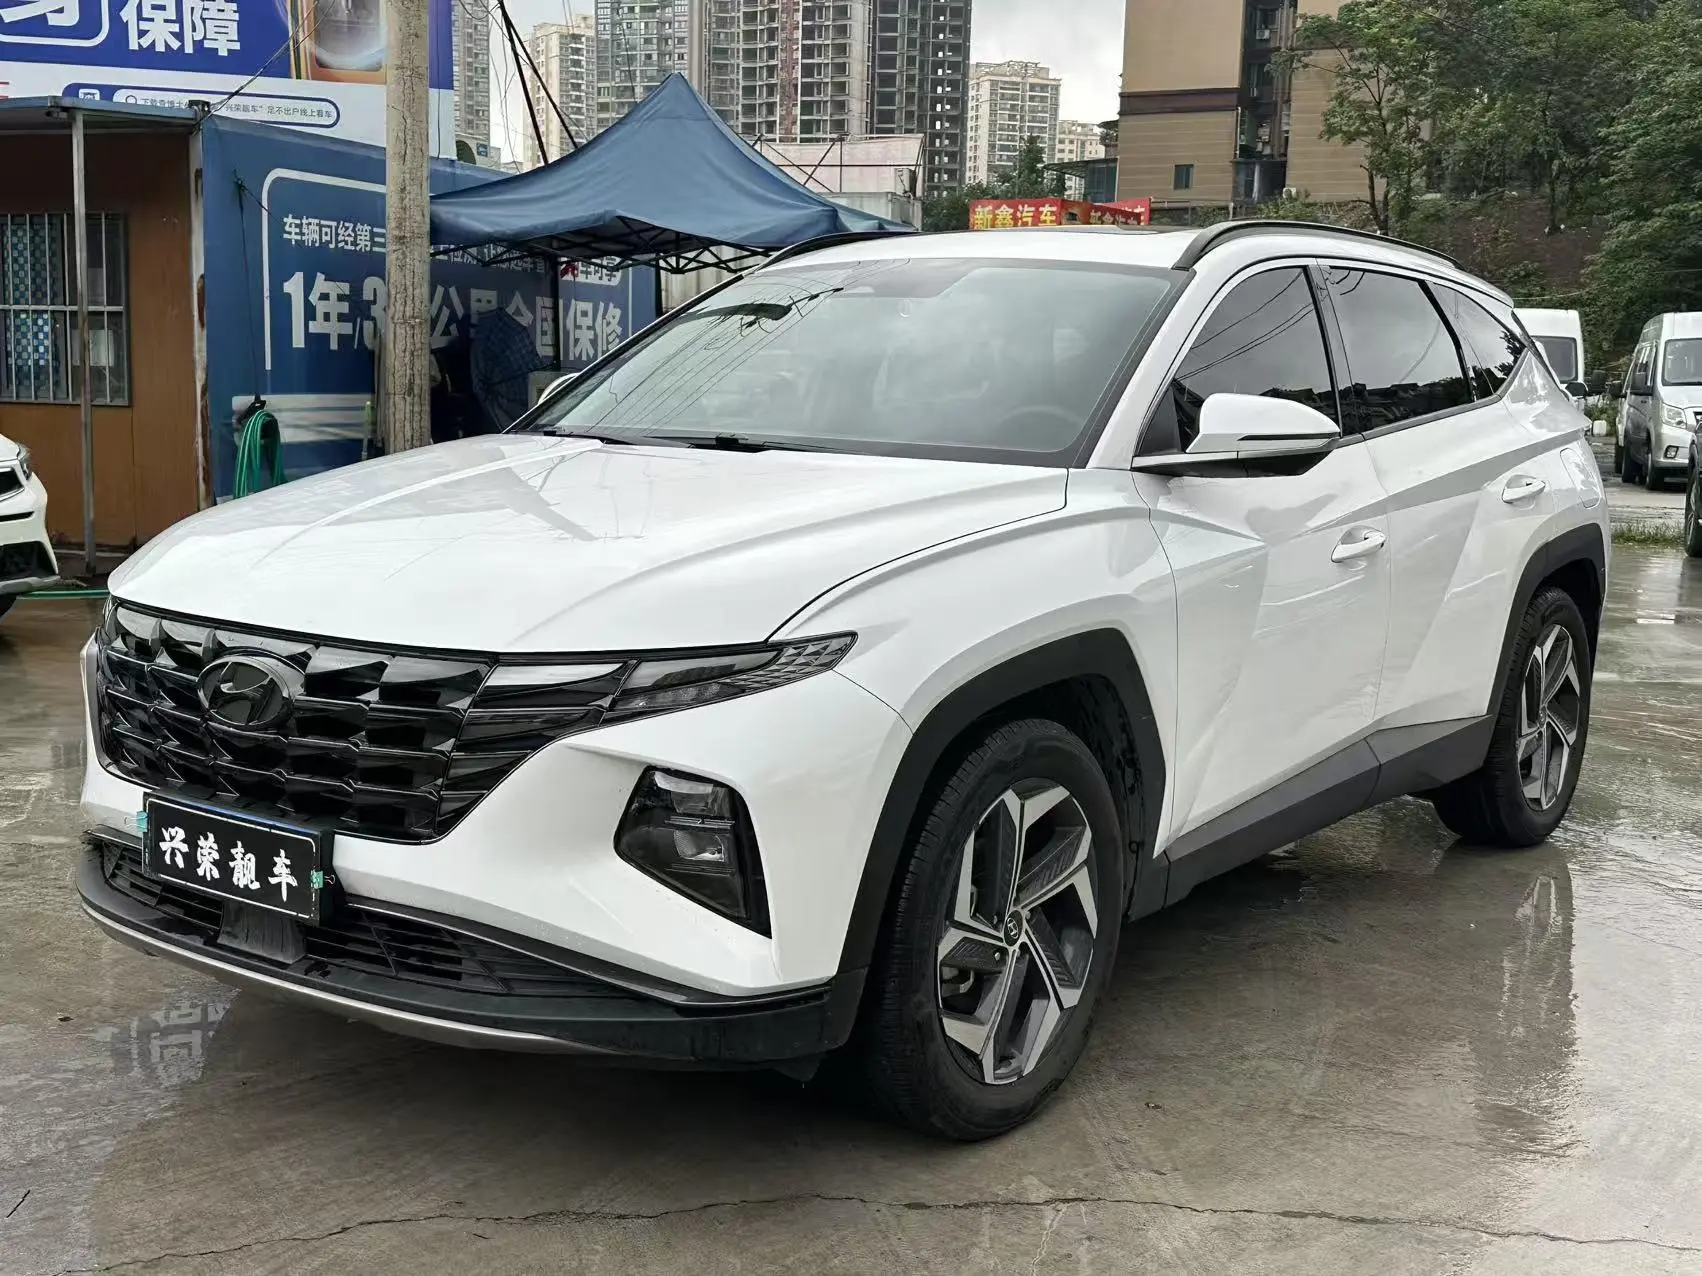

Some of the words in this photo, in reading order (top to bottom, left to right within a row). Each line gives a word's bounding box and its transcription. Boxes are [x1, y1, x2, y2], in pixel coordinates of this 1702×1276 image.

[119, 0, 241, 56] 保障
[283, 214, 387, 252] 车辆可经第三
[159, 826, 298, 903] 兴荣靓车
